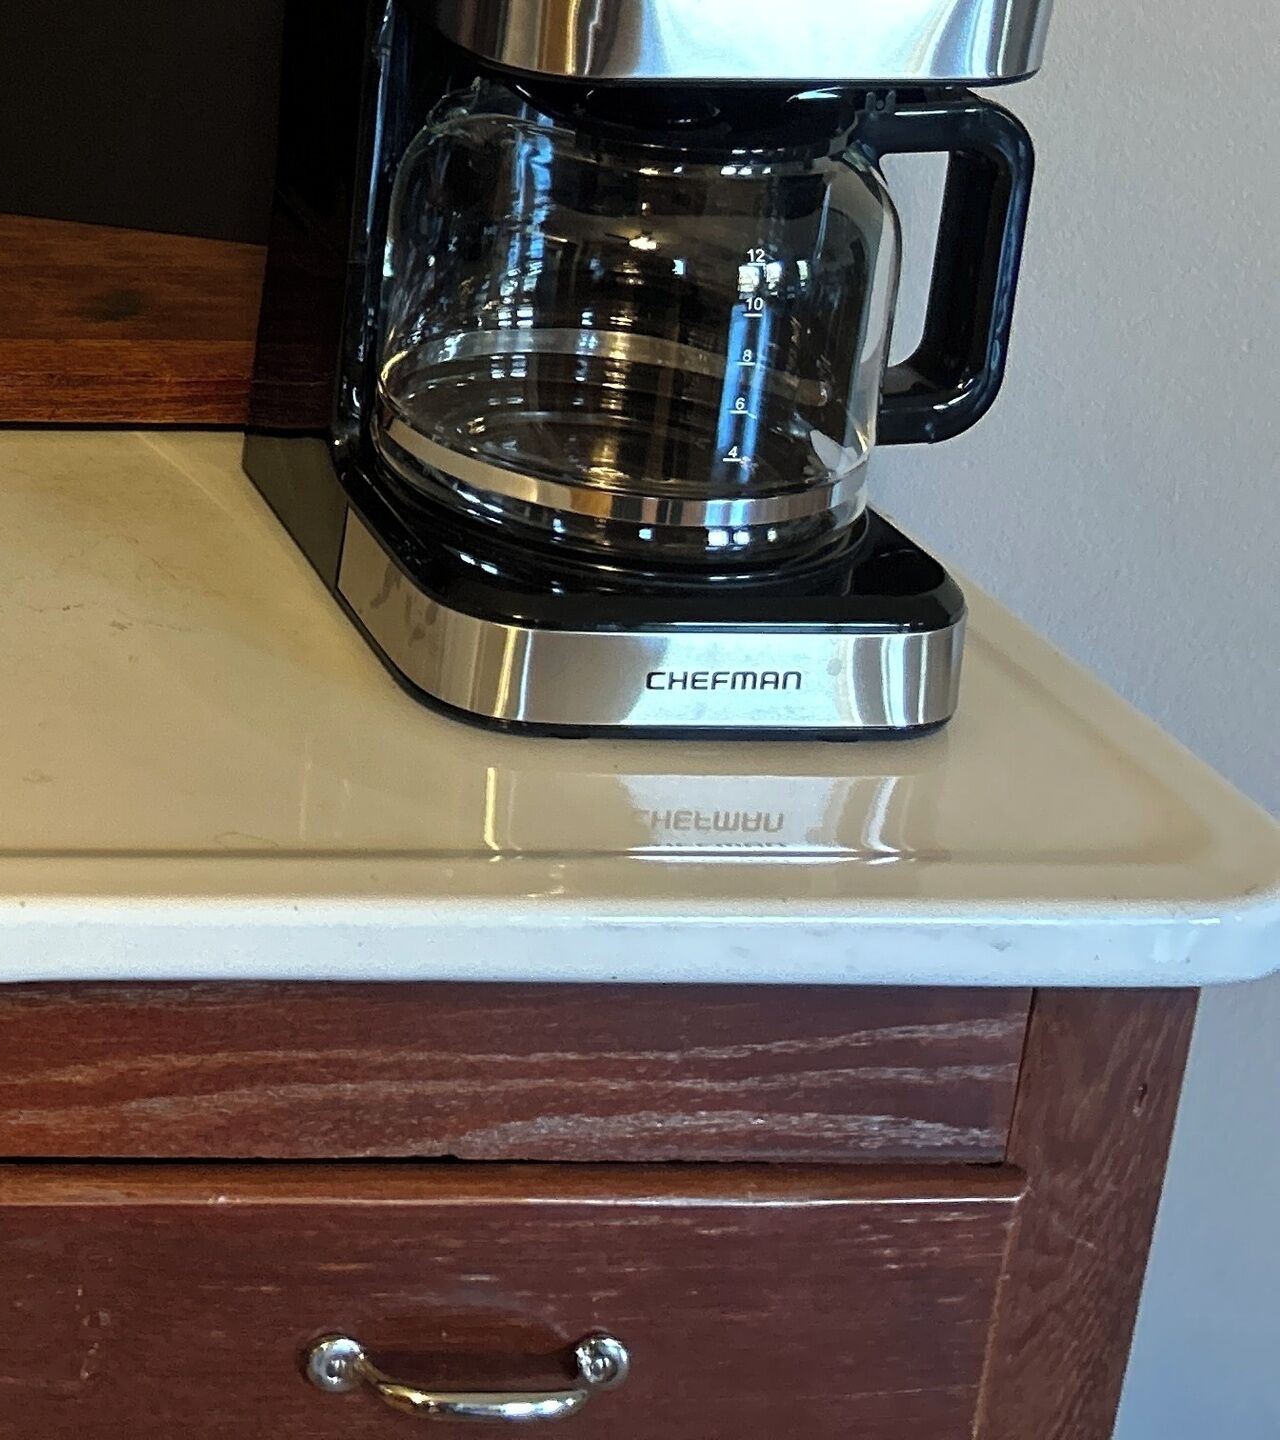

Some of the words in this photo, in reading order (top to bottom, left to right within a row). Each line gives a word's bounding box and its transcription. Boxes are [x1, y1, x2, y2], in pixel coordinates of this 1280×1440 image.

[746, 249, 766, 262] 12
[746, 297, 765, 311] 10
[742, 349, 752, 362] 8
[735, 397, 745, 410] 6
[728, 445, 738, 458] 4
[645, 670, 803, 691] CHEFMAN
